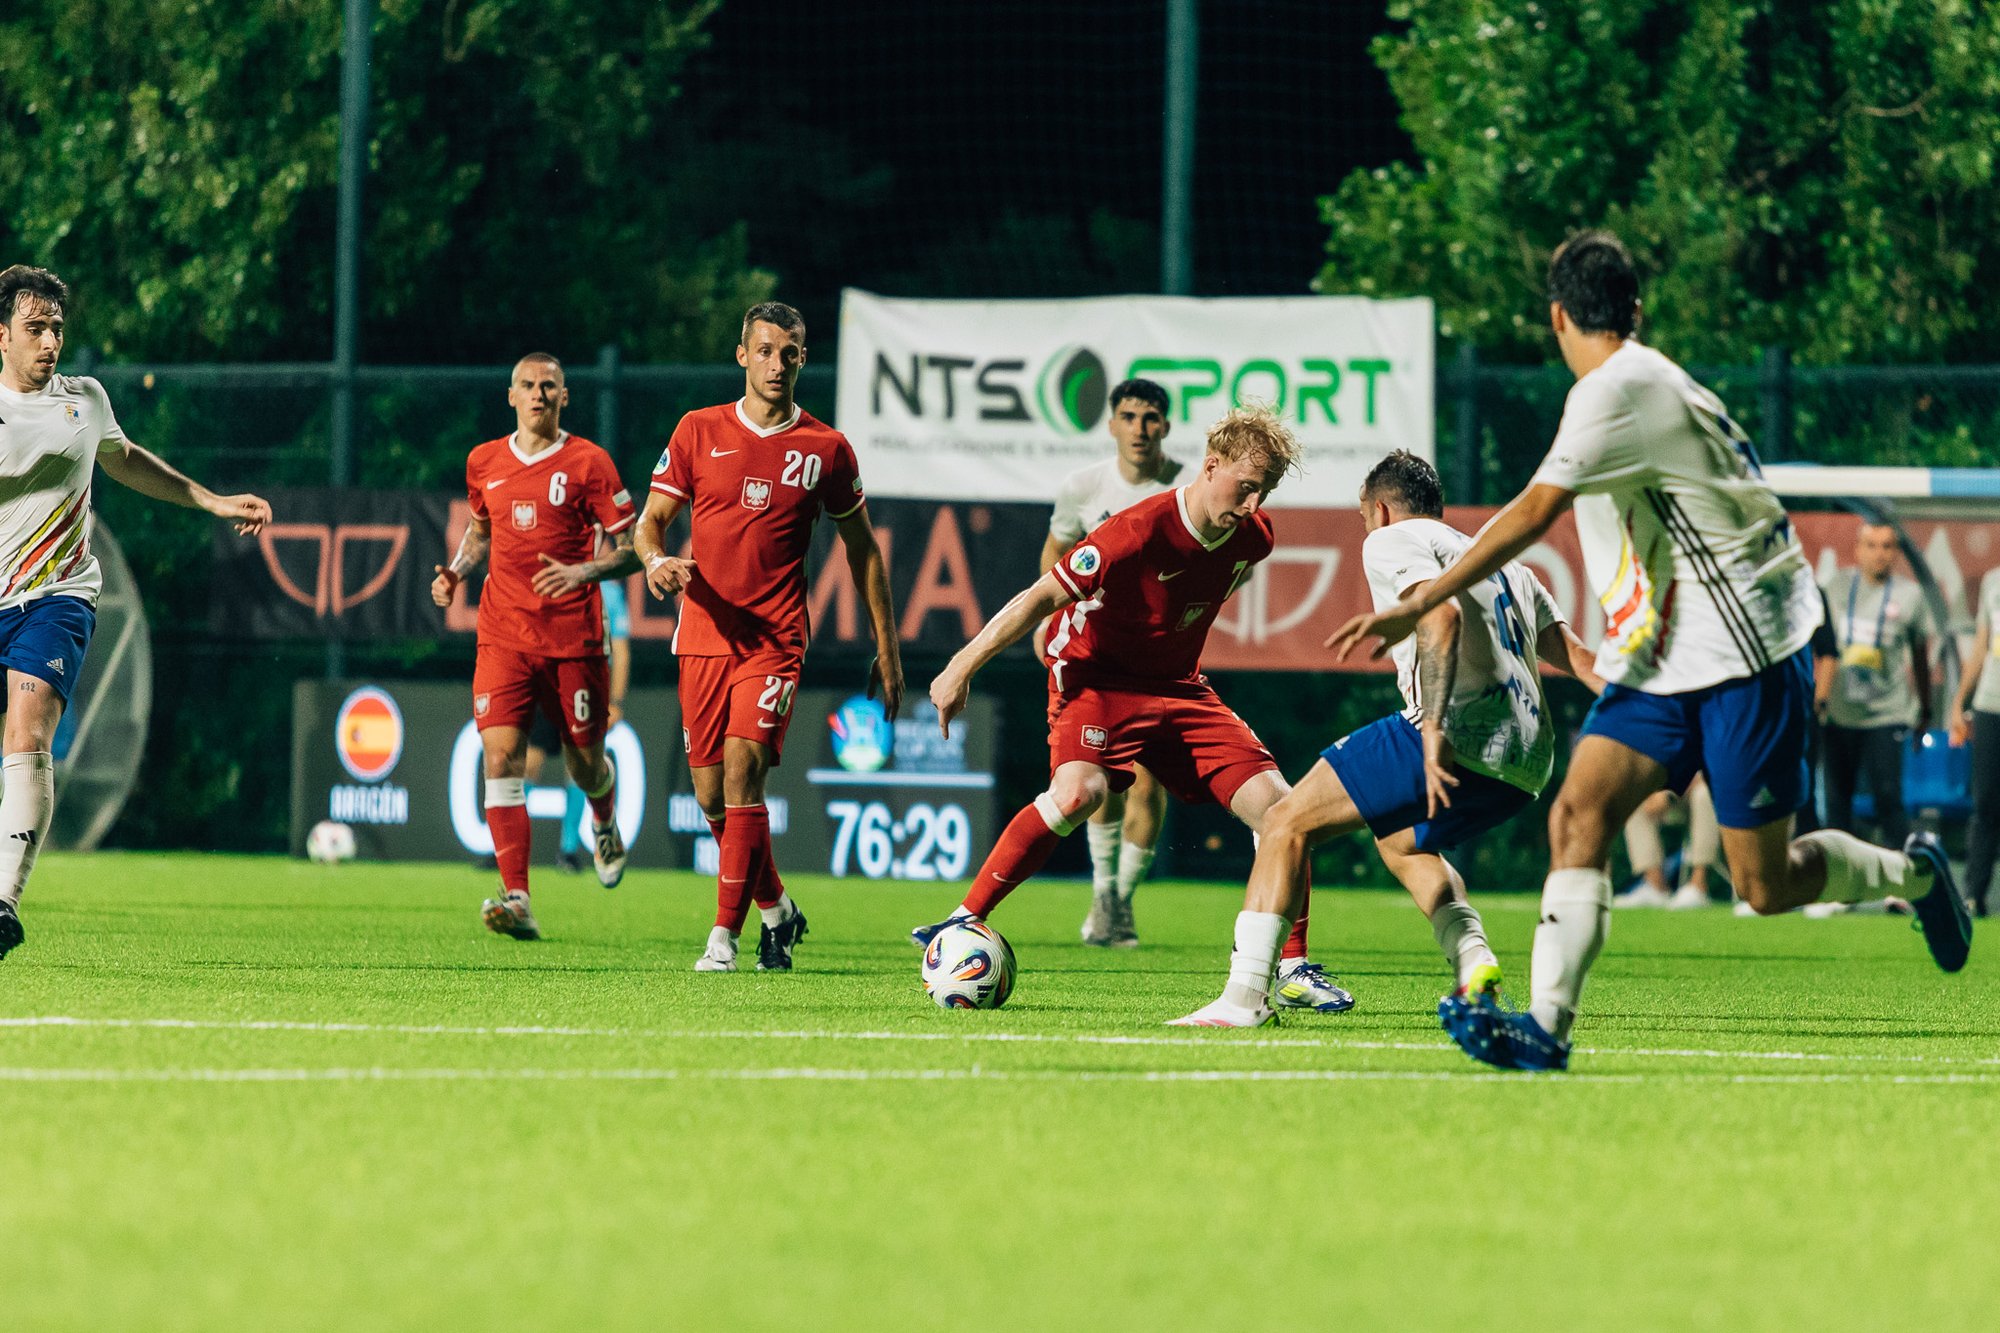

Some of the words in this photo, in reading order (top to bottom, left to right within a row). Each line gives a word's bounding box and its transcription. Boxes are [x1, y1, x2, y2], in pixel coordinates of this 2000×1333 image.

[872, 351, 1033, 421] NTS
[548, 471, 569, 507] 6
[780, 449, 822, 491] 20
[1223, 560, 1249, 601] 7
[573, 688, 591, 723] 6
[756, 675, 796, 716] 20
[826, 800, 971, 881] 76:29
